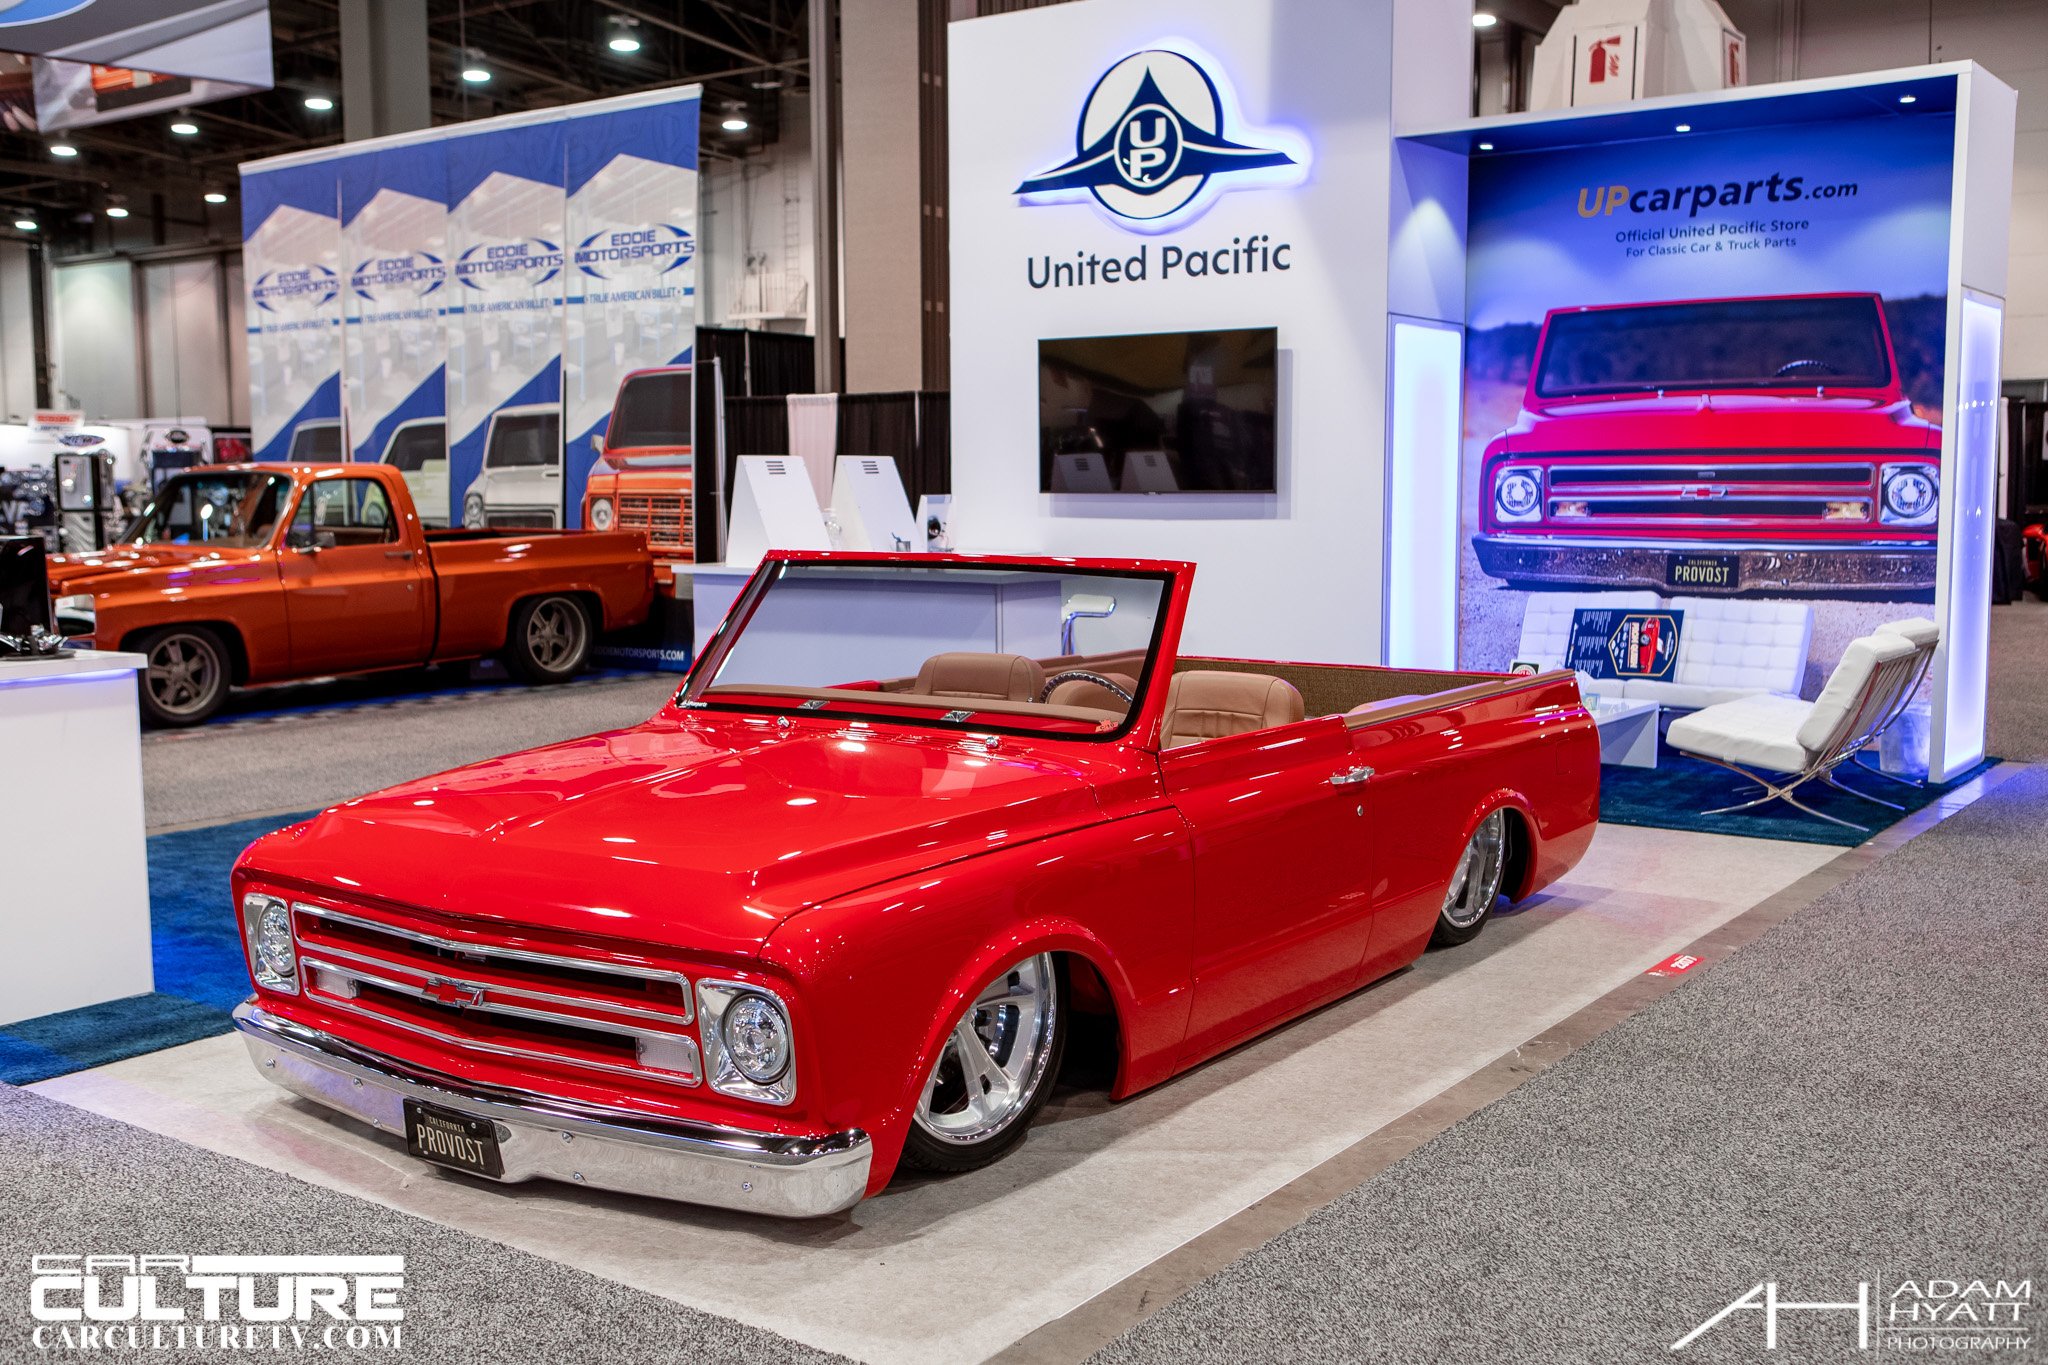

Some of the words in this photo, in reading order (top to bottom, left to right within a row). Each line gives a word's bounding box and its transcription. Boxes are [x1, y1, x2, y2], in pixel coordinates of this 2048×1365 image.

[1577, 171, 1858, 218] UPcarparts.com
[611, 229, 656, 246] EDDIE
[1615, 227, 1665, 243] Official
[1669, 224, 1715, 240] United
[1719, 220, 1766, 236] Pacific
[1770, 218, 1809, 232] Store
[486, 243, 528, 260] EDDIE
[574, 240, 695, 264] MOTORSPORTS
[1625, 247, 1646, 258] For
[1649, 242, 1685, 257] Classic
[1690, 241, 1711, 254] Car
[1714, 240, 1723, 252] &
[1728, 238, 1761, 252] Truck
[1764, 235, 1797, 249] Parts
[378, 257, 414, 272] EDDIE
[455, 253, 564, 276] MOTORSPORTS
[1027, 244, 1147, 289] United
[1161, 234, 1292, 280] Pacific
[351, 266, 447, 287] MOTORSPORTS
[589, 292, 609, 304] TRUE
[610, 289, 650, 302] AMERICAN
[651, 286, 676, 299] BILLET
[1674, 565, 1730, 584] PROVOST
[428, 1116, 466, 1133] CALIFORNIA
[416, 1123, 485, 1166] PROVOST
